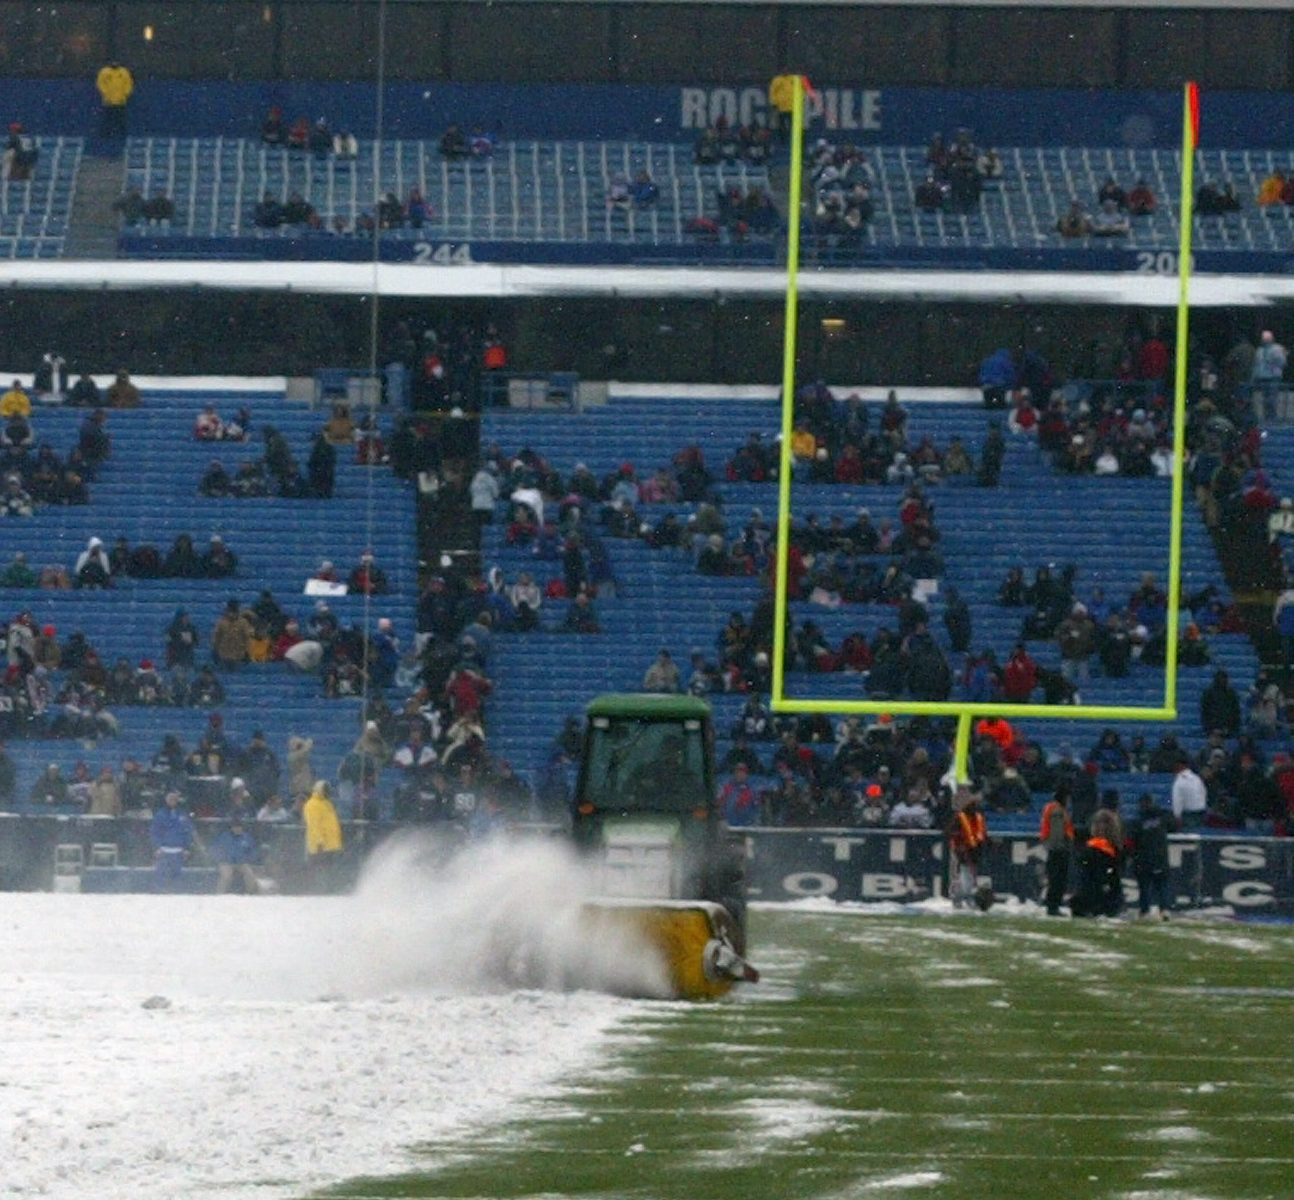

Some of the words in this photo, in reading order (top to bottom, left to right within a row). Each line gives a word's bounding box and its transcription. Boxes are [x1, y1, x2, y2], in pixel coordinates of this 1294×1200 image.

[681, 87, 881, 129] ROCPILE
[412, 242, 472, 264] 244
[821, 837, 1266, 869] TIKTS
